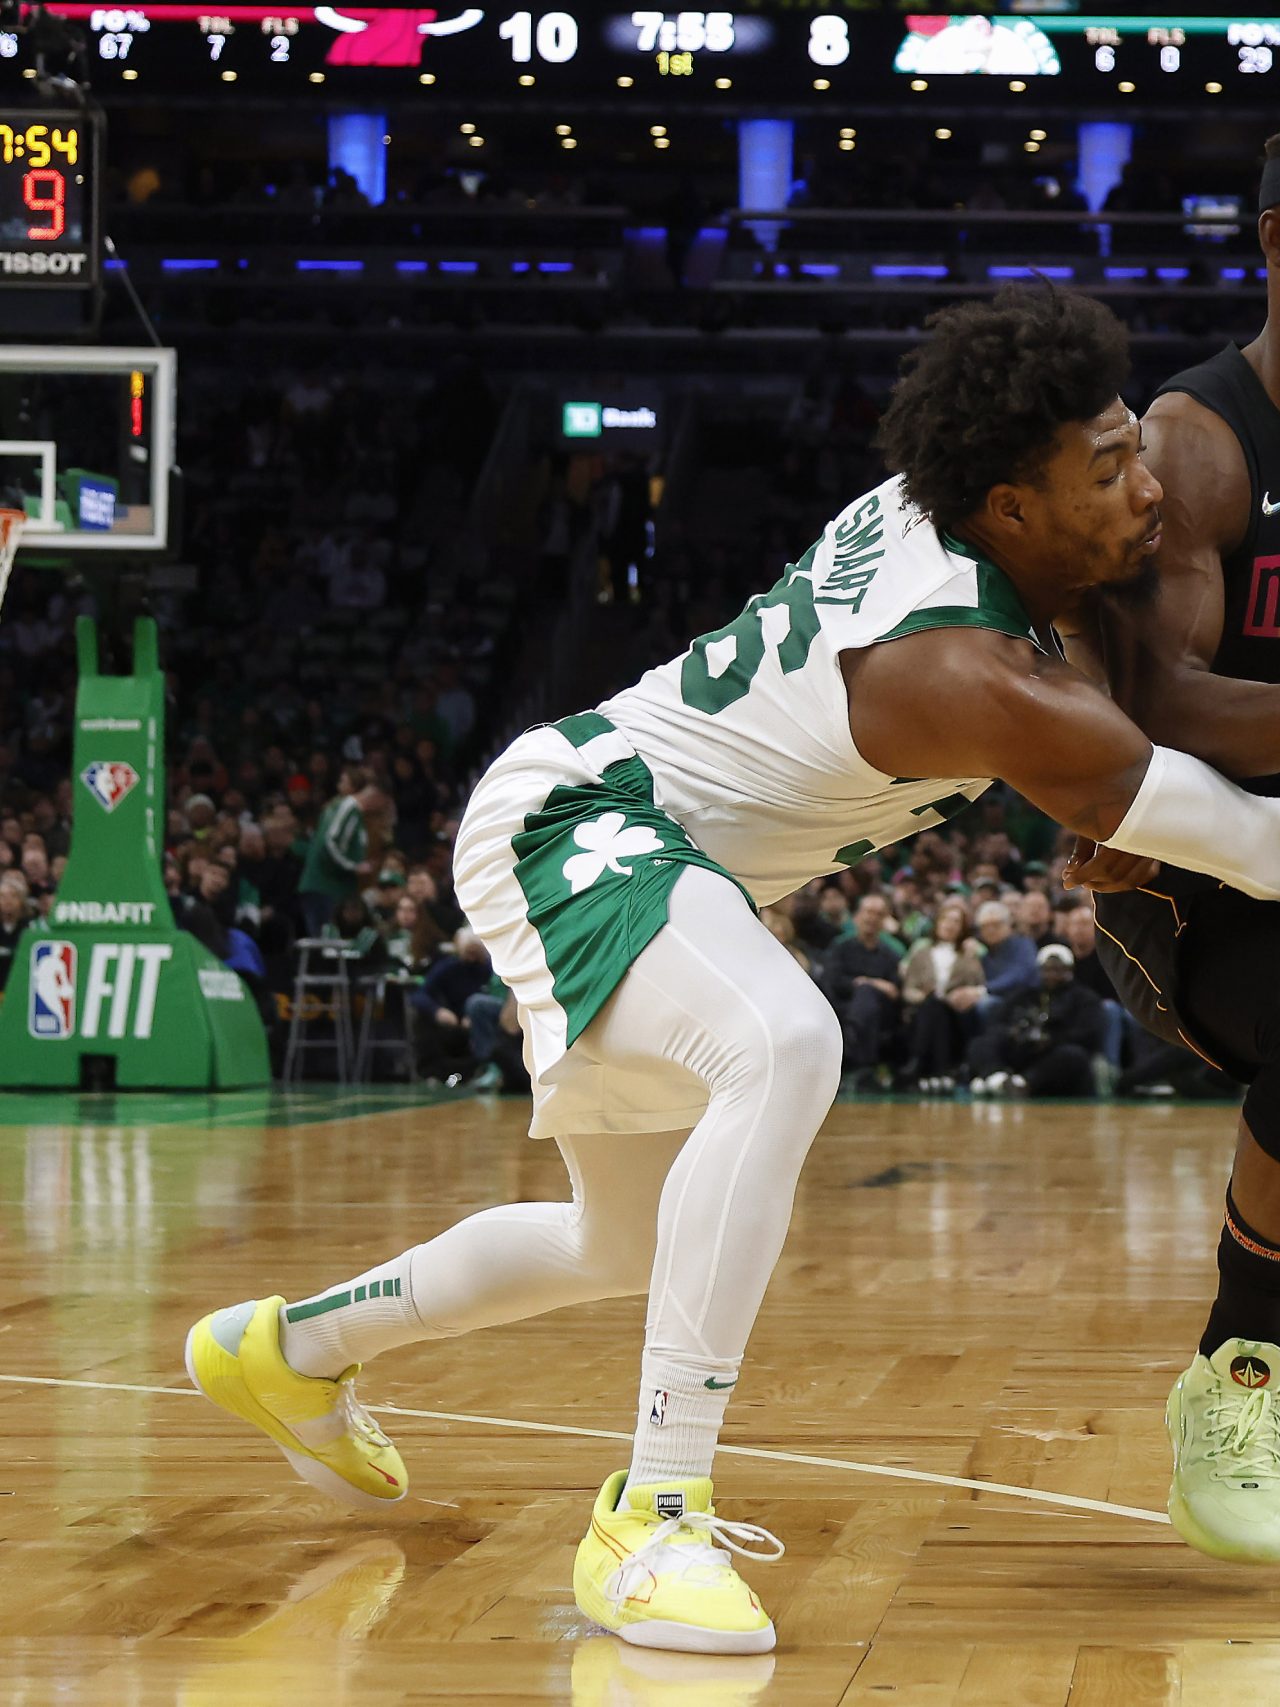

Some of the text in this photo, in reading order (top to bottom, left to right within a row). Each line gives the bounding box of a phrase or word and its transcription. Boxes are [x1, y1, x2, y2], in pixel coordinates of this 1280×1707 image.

[100, 33, 133, 59] 67
[207, 35, 225, 61] 7
[271, 36, 290, 61] 2
[500, 12, 578, 63] 10
[631, 12, 735, 52] 7:55
[808, 15, 850, 66] 8
[0, 124, 78, 168] 7:54
[23, 169, 66, 240] 9
[0, 252, 87, 274] ISSOT
[602, 407, 656, 428] Bank
[813, 494, 886, 615] SMART
[55, 902, 154, 924] #NBAFIT
[81, 944, 172, 1037] FIT
[658, 1495, 682, 1507] PUMA
